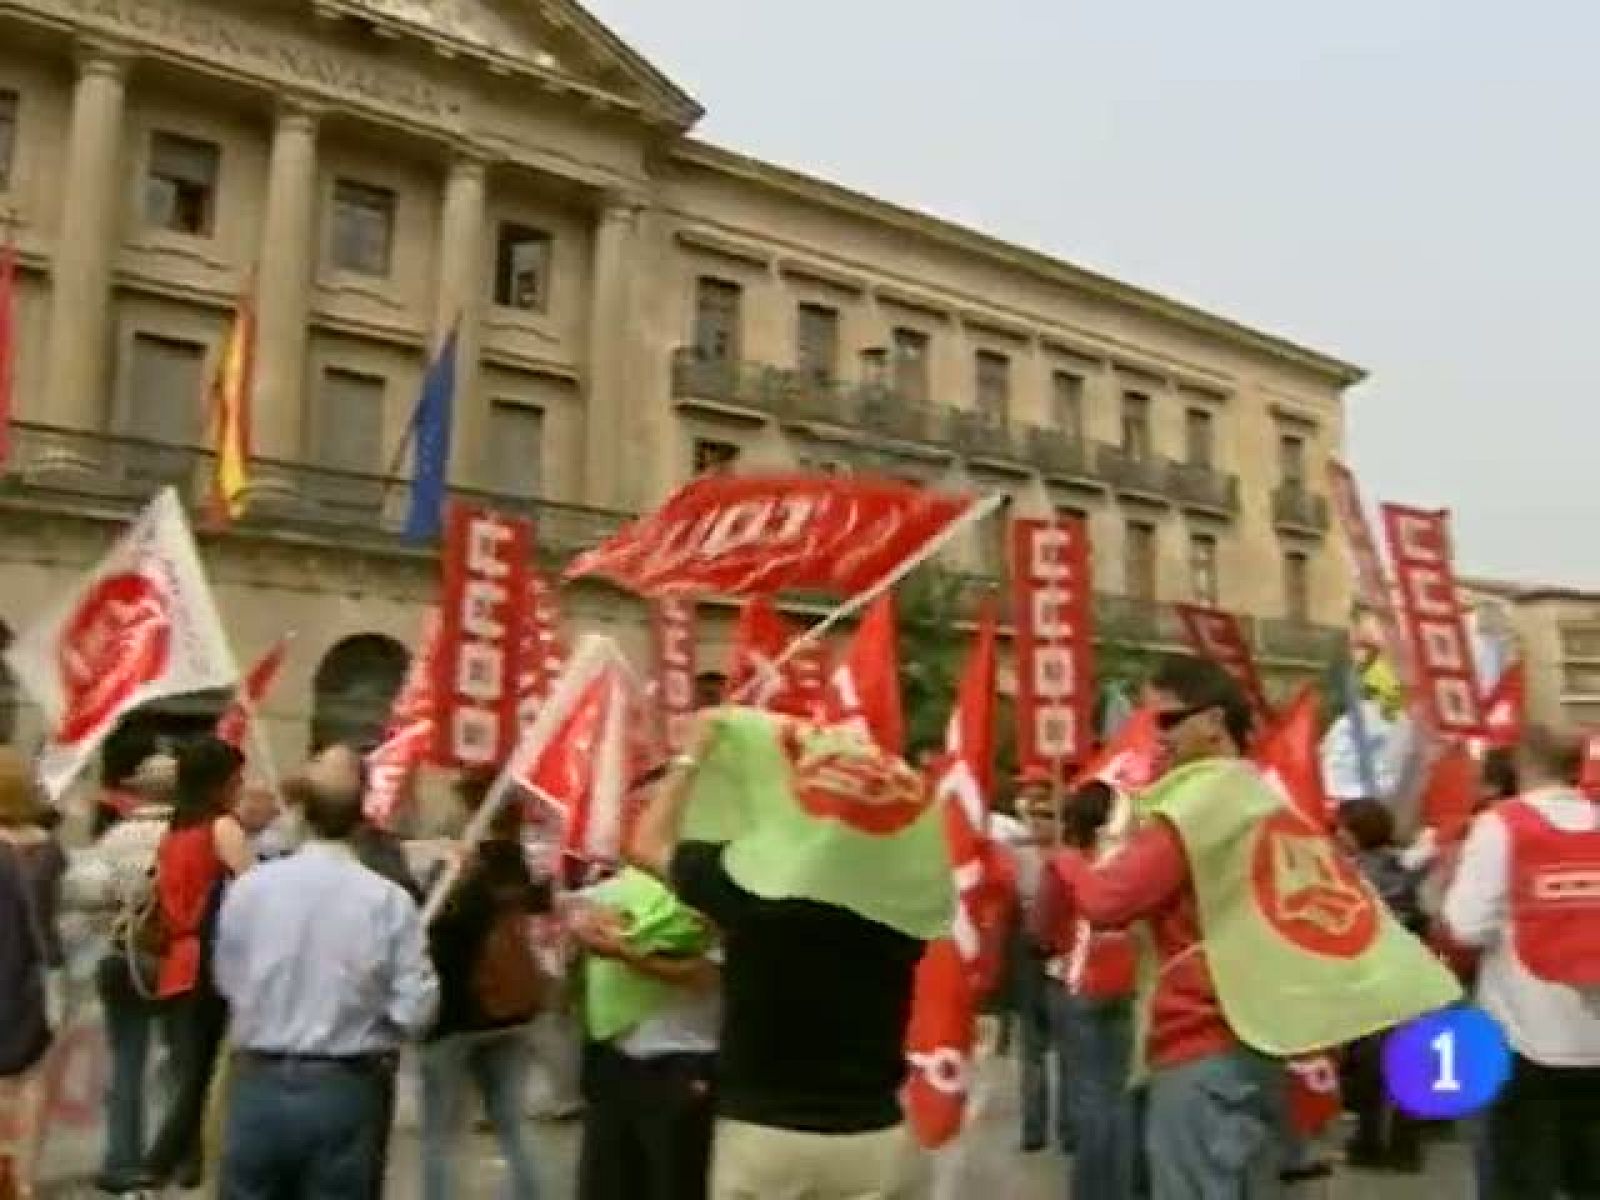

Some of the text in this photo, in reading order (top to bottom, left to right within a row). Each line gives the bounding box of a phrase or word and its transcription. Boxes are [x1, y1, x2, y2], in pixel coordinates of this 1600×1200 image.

[452, 517, 516, 764] CCOO
[1029, 526, 1077, 757] CCOO
[1396, 515, 1478, 727] CCOO
